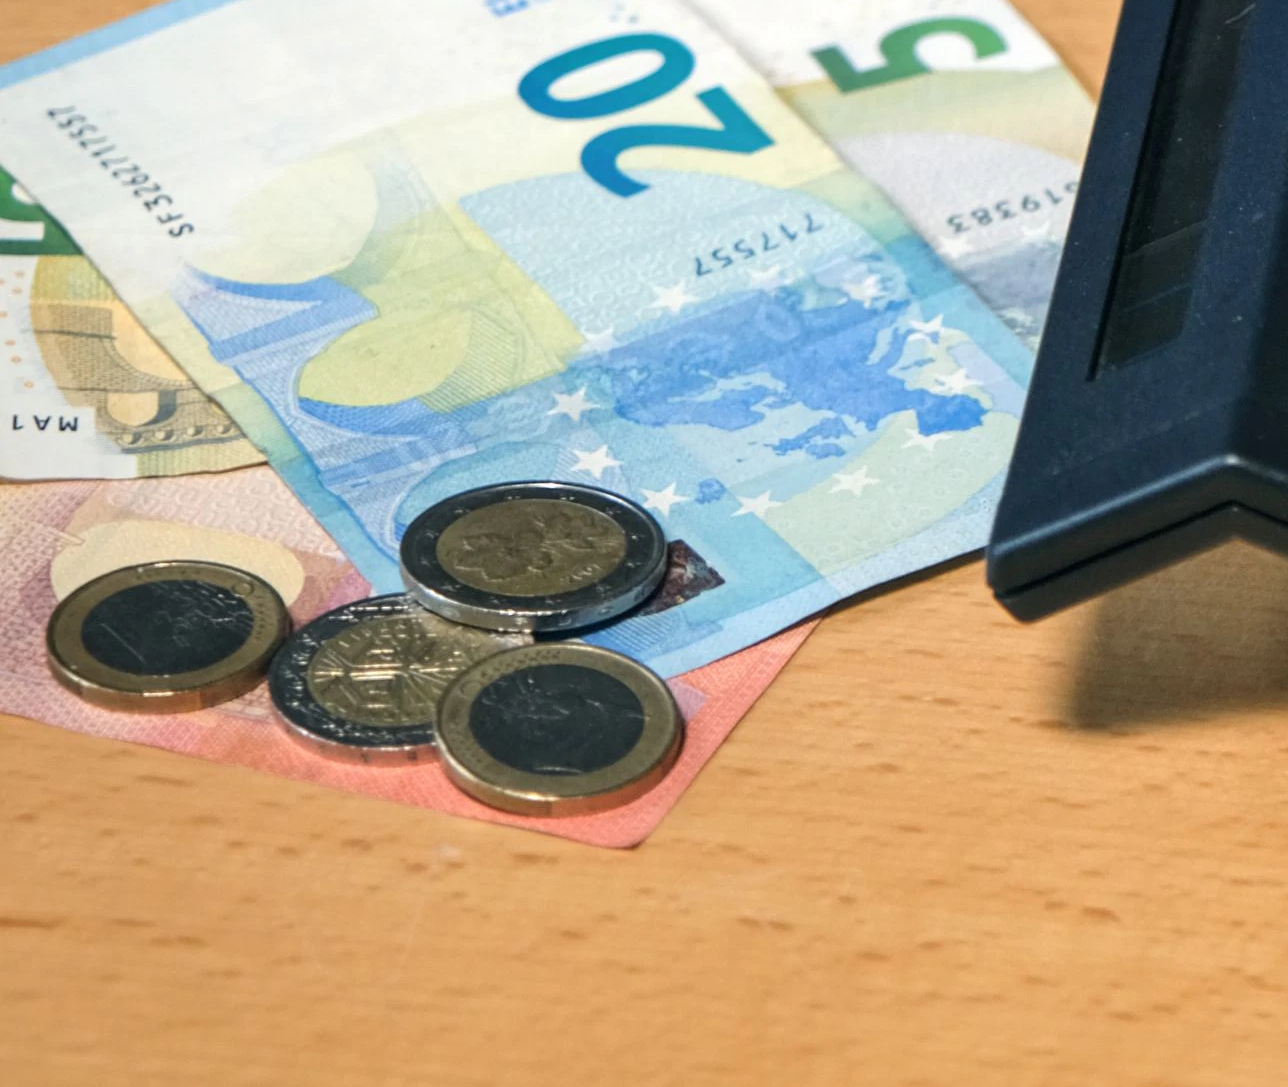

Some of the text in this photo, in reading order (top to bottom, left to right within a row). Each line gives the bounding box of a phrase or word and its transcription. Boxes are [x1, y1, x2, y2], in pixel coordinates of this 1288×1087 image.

[810, 16, 1008, 94] 5
[518, 32, 775, 198] 20
[695, 213, 824, 276] 717557
